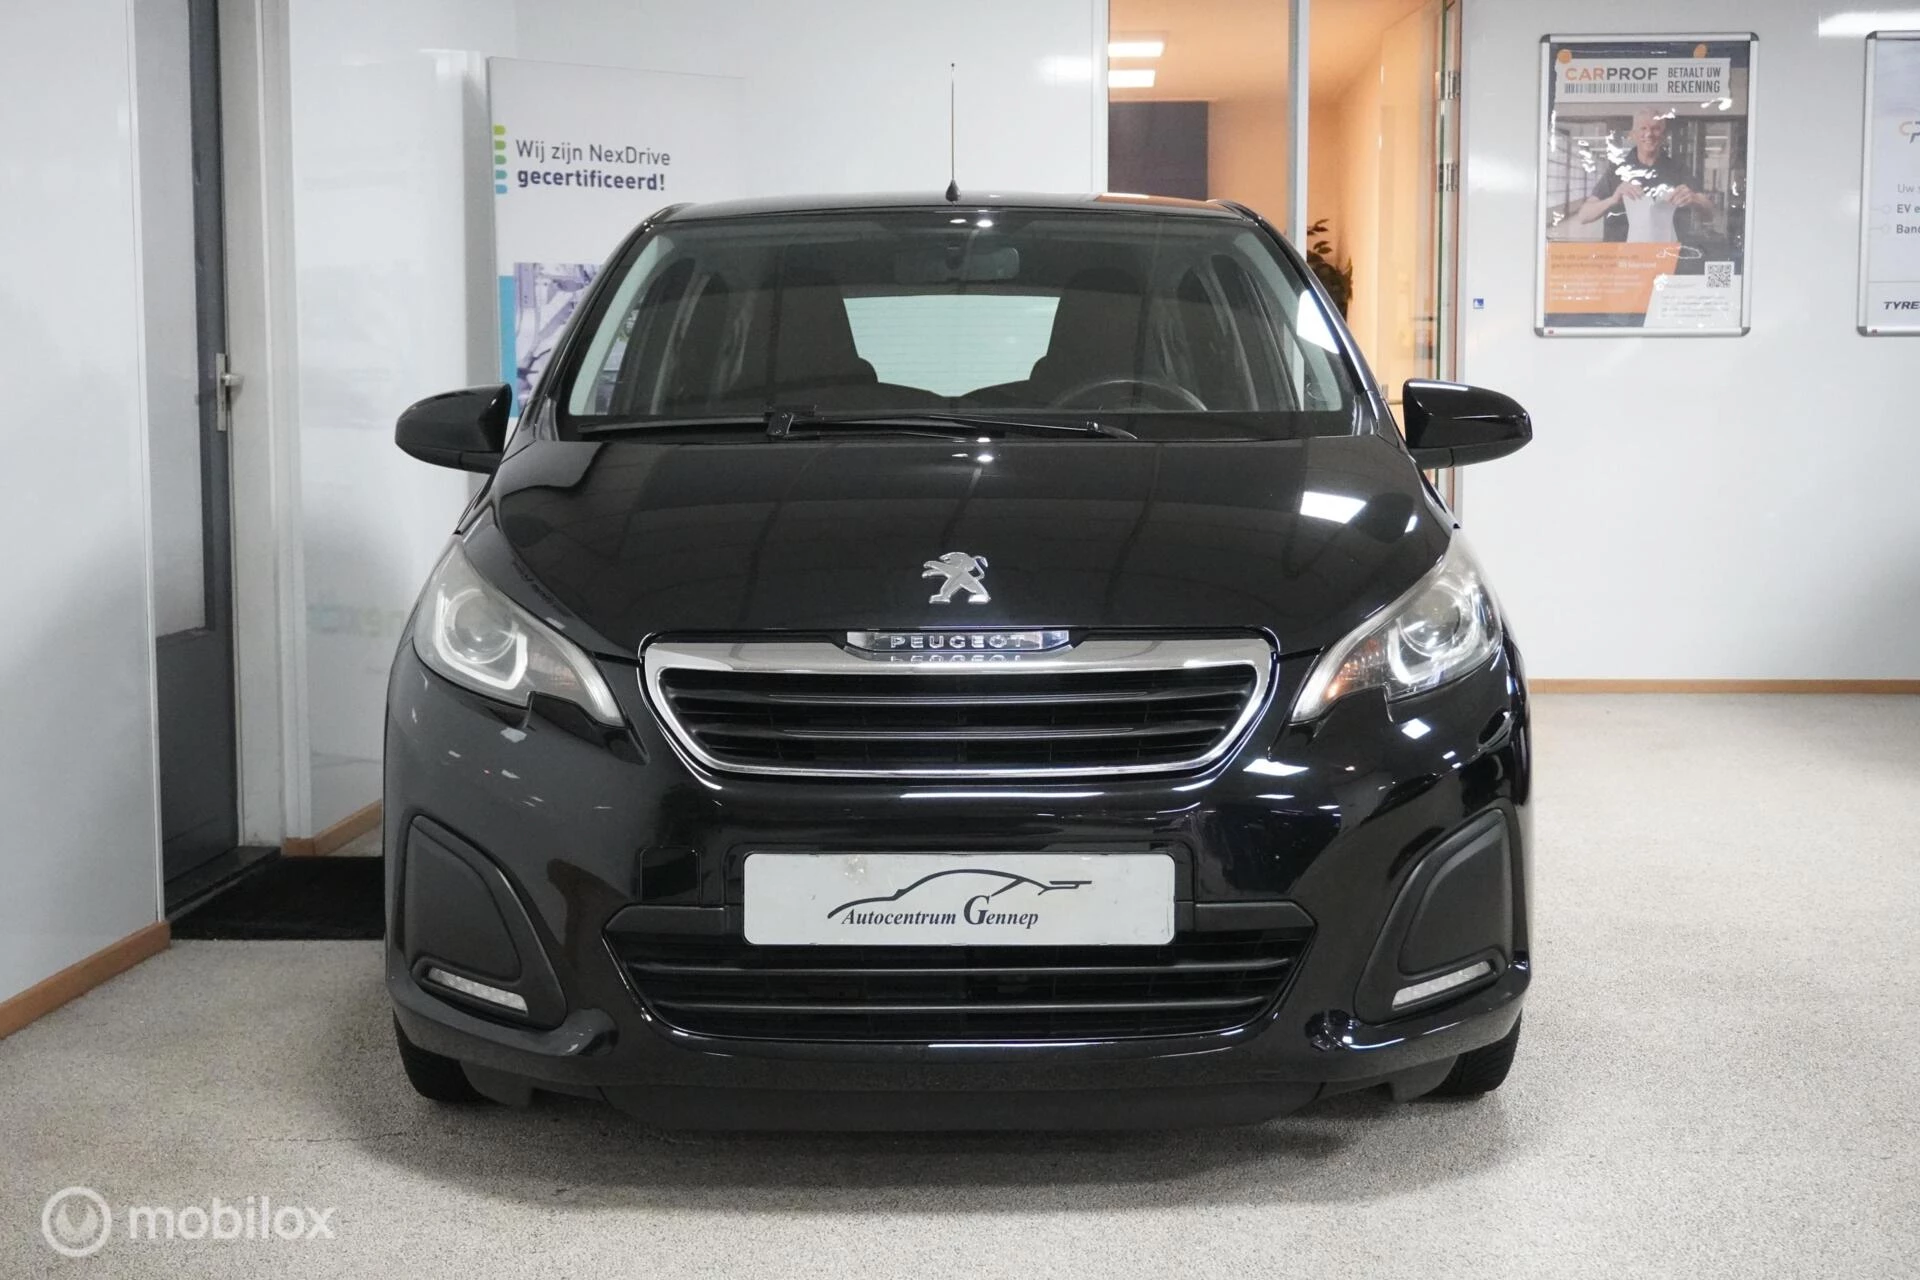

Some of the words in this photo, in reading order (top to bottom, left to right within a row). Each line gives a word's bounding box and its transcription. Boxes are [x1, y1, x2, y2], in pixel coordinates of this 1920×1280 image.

[1565, 67, 1658, 81] CARPROF
[1668, 67, 1704, 78] BETAALT
[1706, 67, 1721, 78] UW
[1668, 81, 1720, 93] REKENING
[516, 139, 545, 163] Wij
[551, 142, 582, 164] zijn
[590, 144, 671, 166] NexDrive
[517, 169, 665, 191] gecertificeerd!
[1896, 204, 1911, 214] EV
[890, 634, 1025, 649] PEUGEOT
[841, 909, 956, 925] Autocentrum
[963, 895, 1039, 929] Gennep
